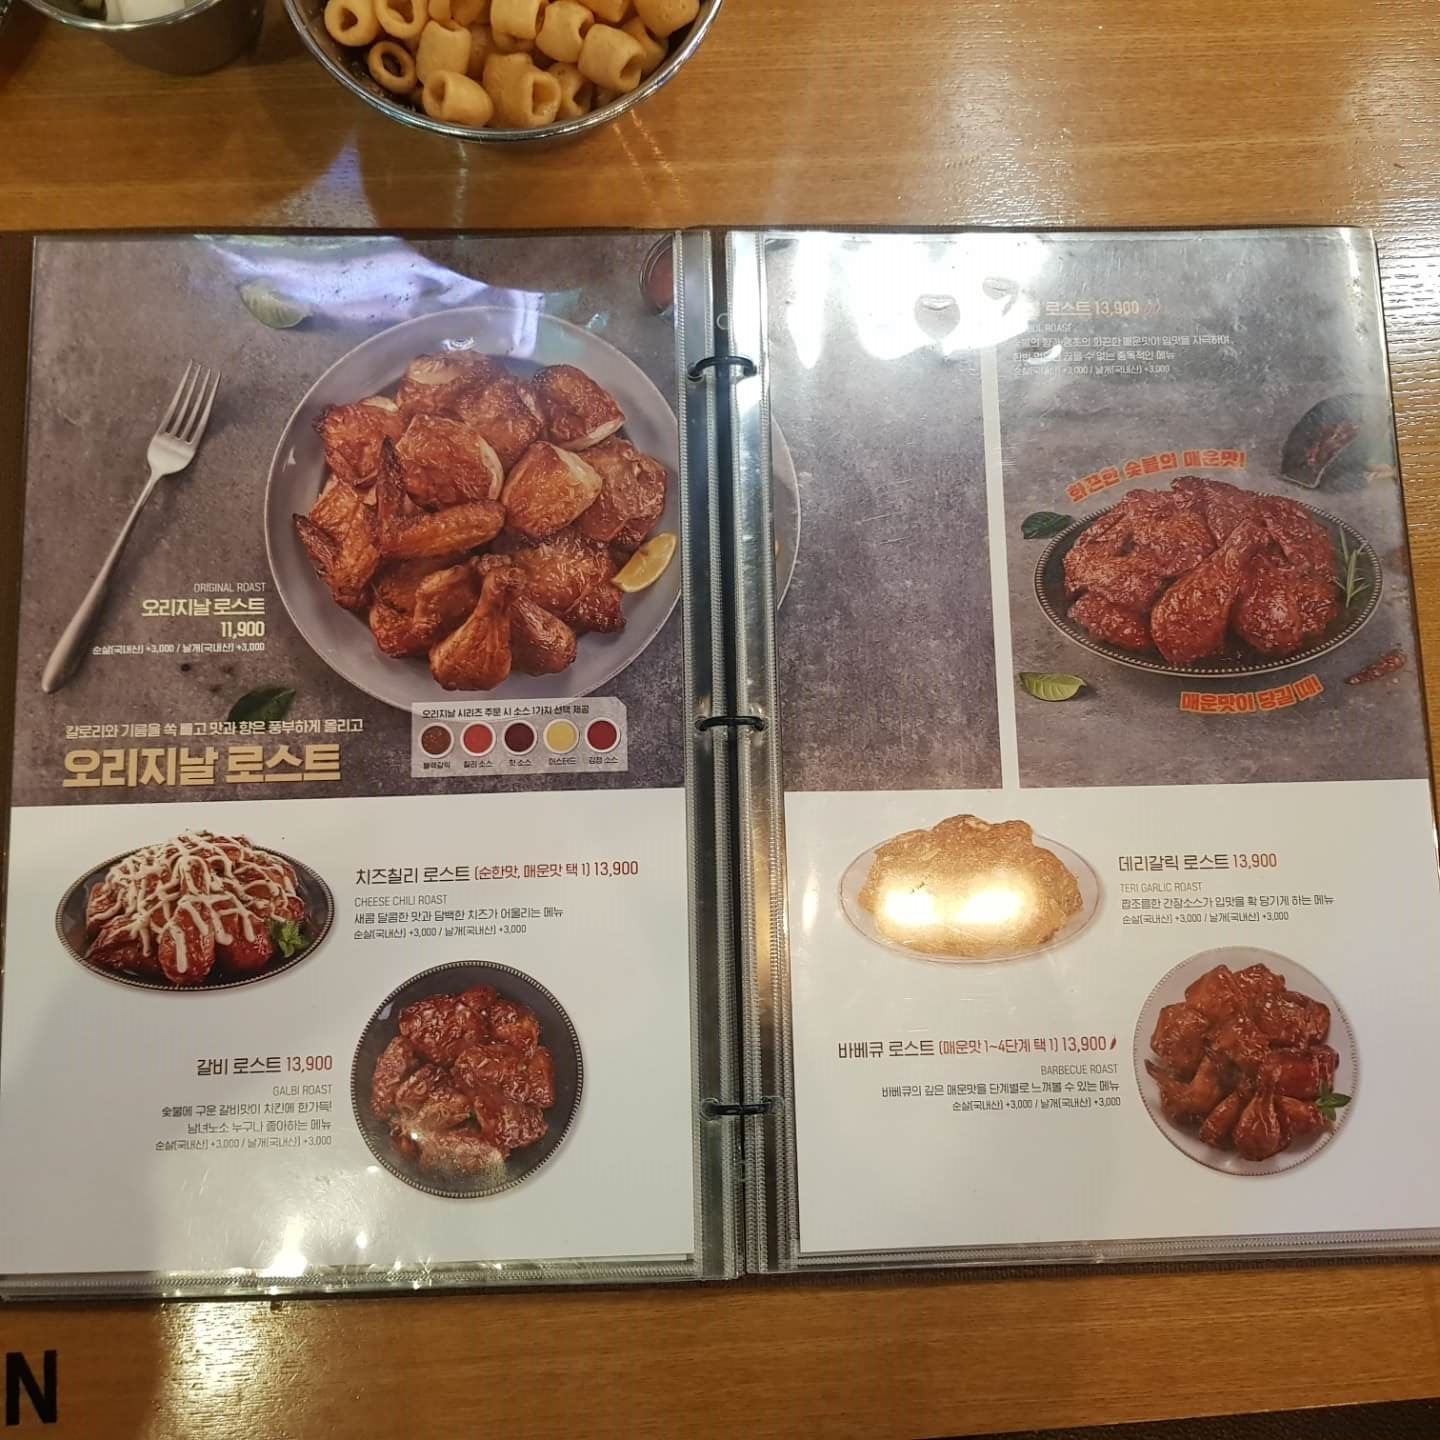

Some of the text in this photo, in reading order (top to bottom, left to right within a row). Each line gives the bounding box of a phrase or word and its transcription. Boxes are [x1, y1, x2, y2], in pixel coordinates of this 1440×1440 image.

[1046, 301, 1092, 316] 로스트
[1066, 449, 1246, 503] 화끈한 숯불의 매운맛!
[193, 582, 266, 593] ORIGINAL ROAST
[141, 597, 265, 617] 오리지날 로스트
[220, 621, 265, 639] 11,900
[1180, 673, 1324, 714] 매운맛이 당길 때!
[485, 704, 590, 717] 주문 소스 제공
[65, 724, 118, 739] 칼로리와
[120, 723, 161, 737] 기름을
[163, 723, 177, 737] 쏙
[209, 720, 237, 735] 맛과
[240, 720, 266, 735] 향은
[268, 719, 321, 734] 풍부하게
[324, 718, 363, 733] 올리고
[62, 743, 341, 788] 오리지날 로스트
[1118, 853, 1278, 872] 데리갈릭 로스트 13,900
[356, 867, 418, 885] 치즈칠리
[423, 866, 471, 882] 로스트
[523, 863, 562, 878] 매운맛
[566, 862, 578, 877] 택
[581, 862, 591, 877] 1)
[595, 861, 639, 877] 13,900
[1141, 881, 1203, 893] GARLIC ROAST
[354, 894, 449, 907] CHEESE CHILI ROAST
[1163, 895, 1290, 909] 간장소스가 입맛을 당기게
[377, 906, 564, 923] 달콤한 맛과 담백한 치즈가 어울리는 메뉴
[838, 1041, 884, 1059] 바베큐
[888, 1040, 935, 1057] 로스트
[938, 1039, 981, 1056] (매운맛
[1033, 1037, 1046, 1053] 택
[1062, 1036, 1106, 1053] 13,900
[197, 1055, 333, 1076] 갈비 로스트 13,900
[1040, 1063, 1119, 1075] BARBECUE ROAST
[272, 1084, 333, 1097] GALBI ROAST
[882, 1080, 1120, 1098] 바베큐의 매운맛을 메뉴
[161, 1100, 332, 1118] 숯불에 구운 갈비맛이 치킨에 한가득!
[187, 1118, 332, 1135] 남녀노소 좋아하는 메뉴
[5, 1350, 58, 1426] N
